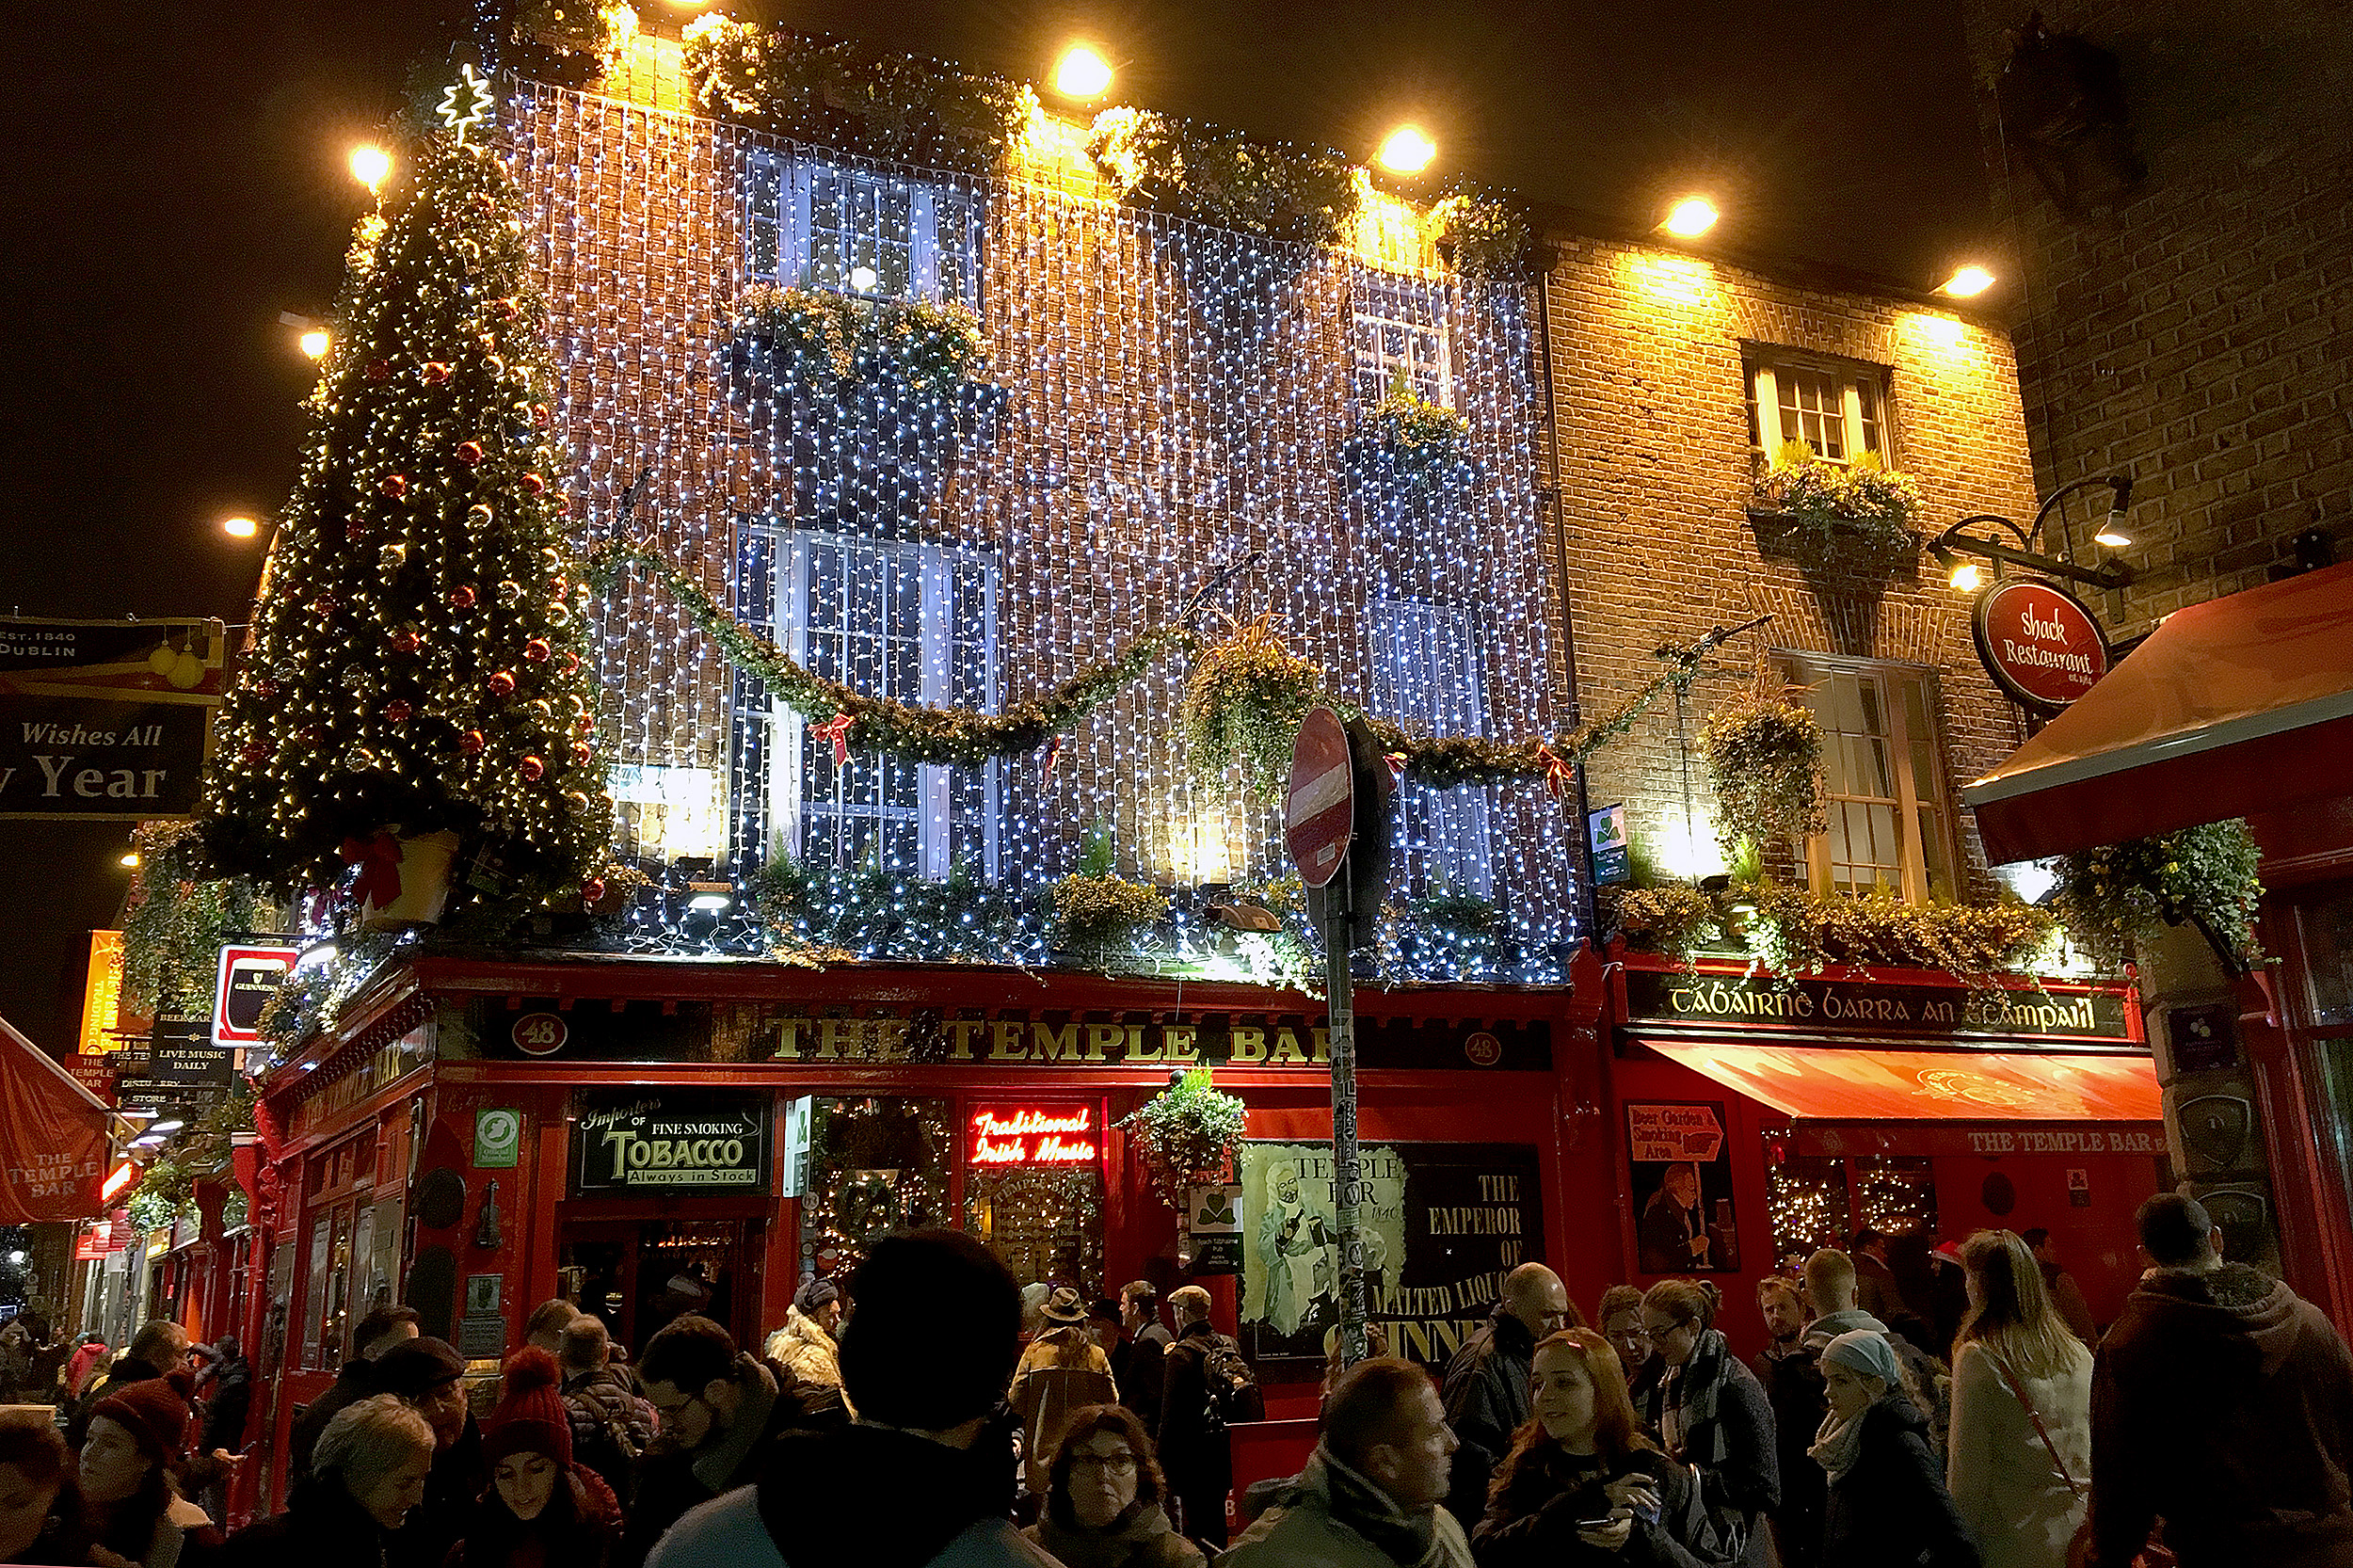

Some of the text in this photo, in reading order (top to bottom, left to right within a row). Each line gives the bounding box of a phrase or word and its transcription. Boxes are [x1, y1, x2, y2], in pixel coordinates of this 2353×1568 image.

[0, 644, 75, 656] DUBLIN
[2003, 639, 2093, 675] Restaurant
[22, 722, 163, 745] Wishes All
[32, 755, 168, 798] Year
[521, 1019, 556, 1044] 48
[764, 1018, 911, 1059] THE
[941, 1020, 1201, 1062] TEMPLE
[158, 1049, 226, 1059] LIVE MUSIC
[1470, 1037, 1493, 1058] 48
[70, 1068, 114, 1078] TEMPLE
[82, 1058, 104, 1067] THE
[172, 1062, 209, 1070] DAILY
[132, 1095, 167, 1103] STORE
[632, 1116, 647, 1127] OF
[652, 1123, 744, 1135] FINE SMOKING
[975, 1108, 1090, 1137] Traditional
[971, 1135, 1096, 1163] Irish Music
[1967, 1132, 2015, 1152] THE
[2018, 1132, 2105, 1152] TEMPLE
[2107, 1132, 2153, 1152] BAR
[35, 1153, 72, 1166] THE
[601, 1130, 744, 1180] TOBACCO
[8, 1161, 99, 1184] TEMPLE
[629, 1168, 754, 1185] Always in Stock
[1293, 1158, 1401, 1179] TEPLE
[31, 1180, 76, 1198] BAR
[1478, 1175, 1520, 1202] THE
[1429, 1208, 1522, 1235] EMPEROR
[1500, 1240, 1523, 1266] OF
[1371, 1271, 1508, 1316] MALTED LIQUO
